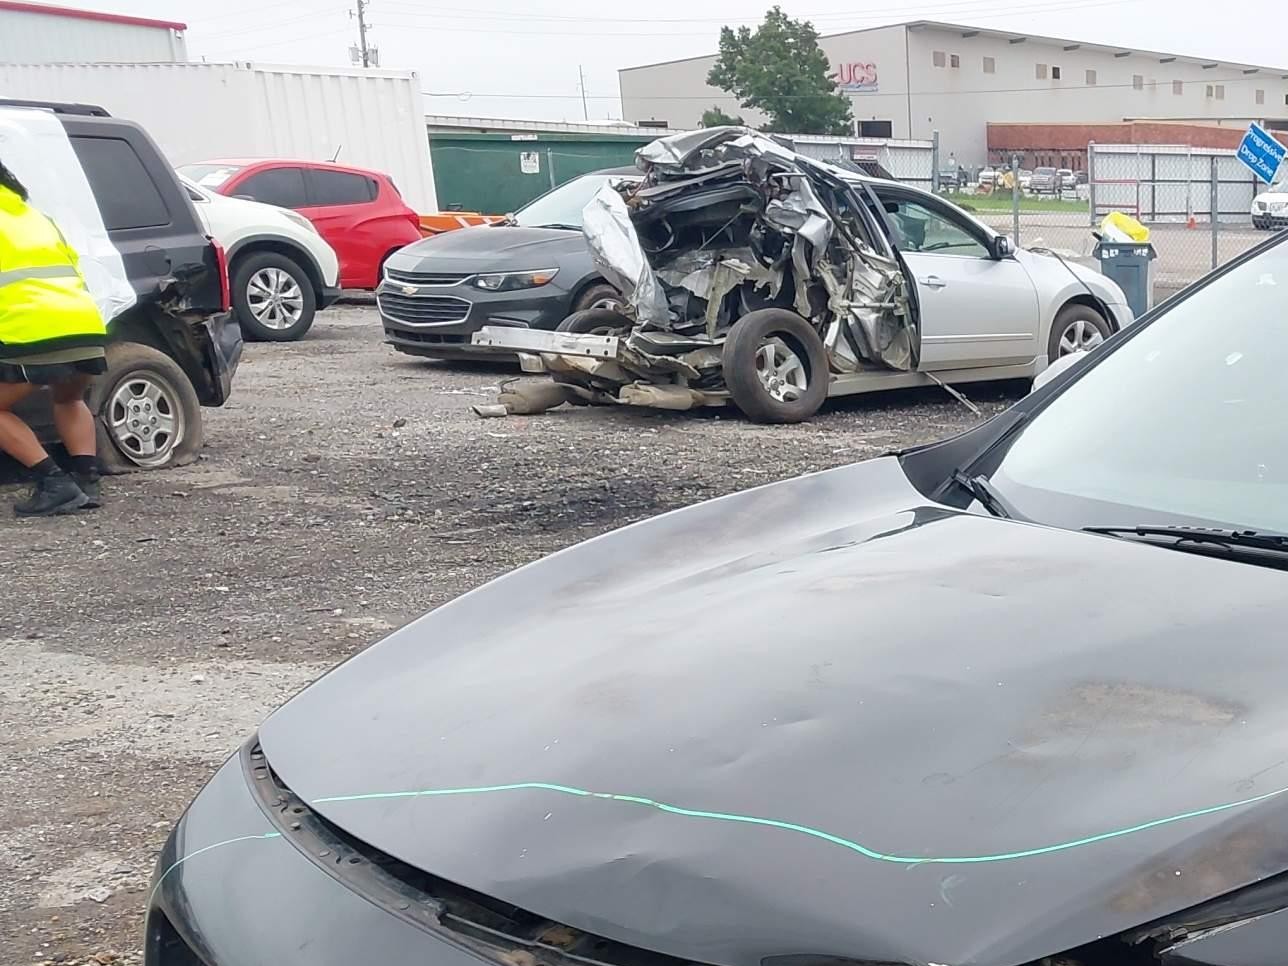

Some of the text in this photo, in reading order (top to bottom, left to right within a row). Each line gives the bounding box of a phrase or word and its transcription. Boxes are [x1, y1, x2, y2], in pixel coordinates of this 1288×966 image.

[839, 63, 878, 85] UCS
[1240, 144, 1274, 176] Drop Zone
[1249, 128, 1284, 162] Progressive
